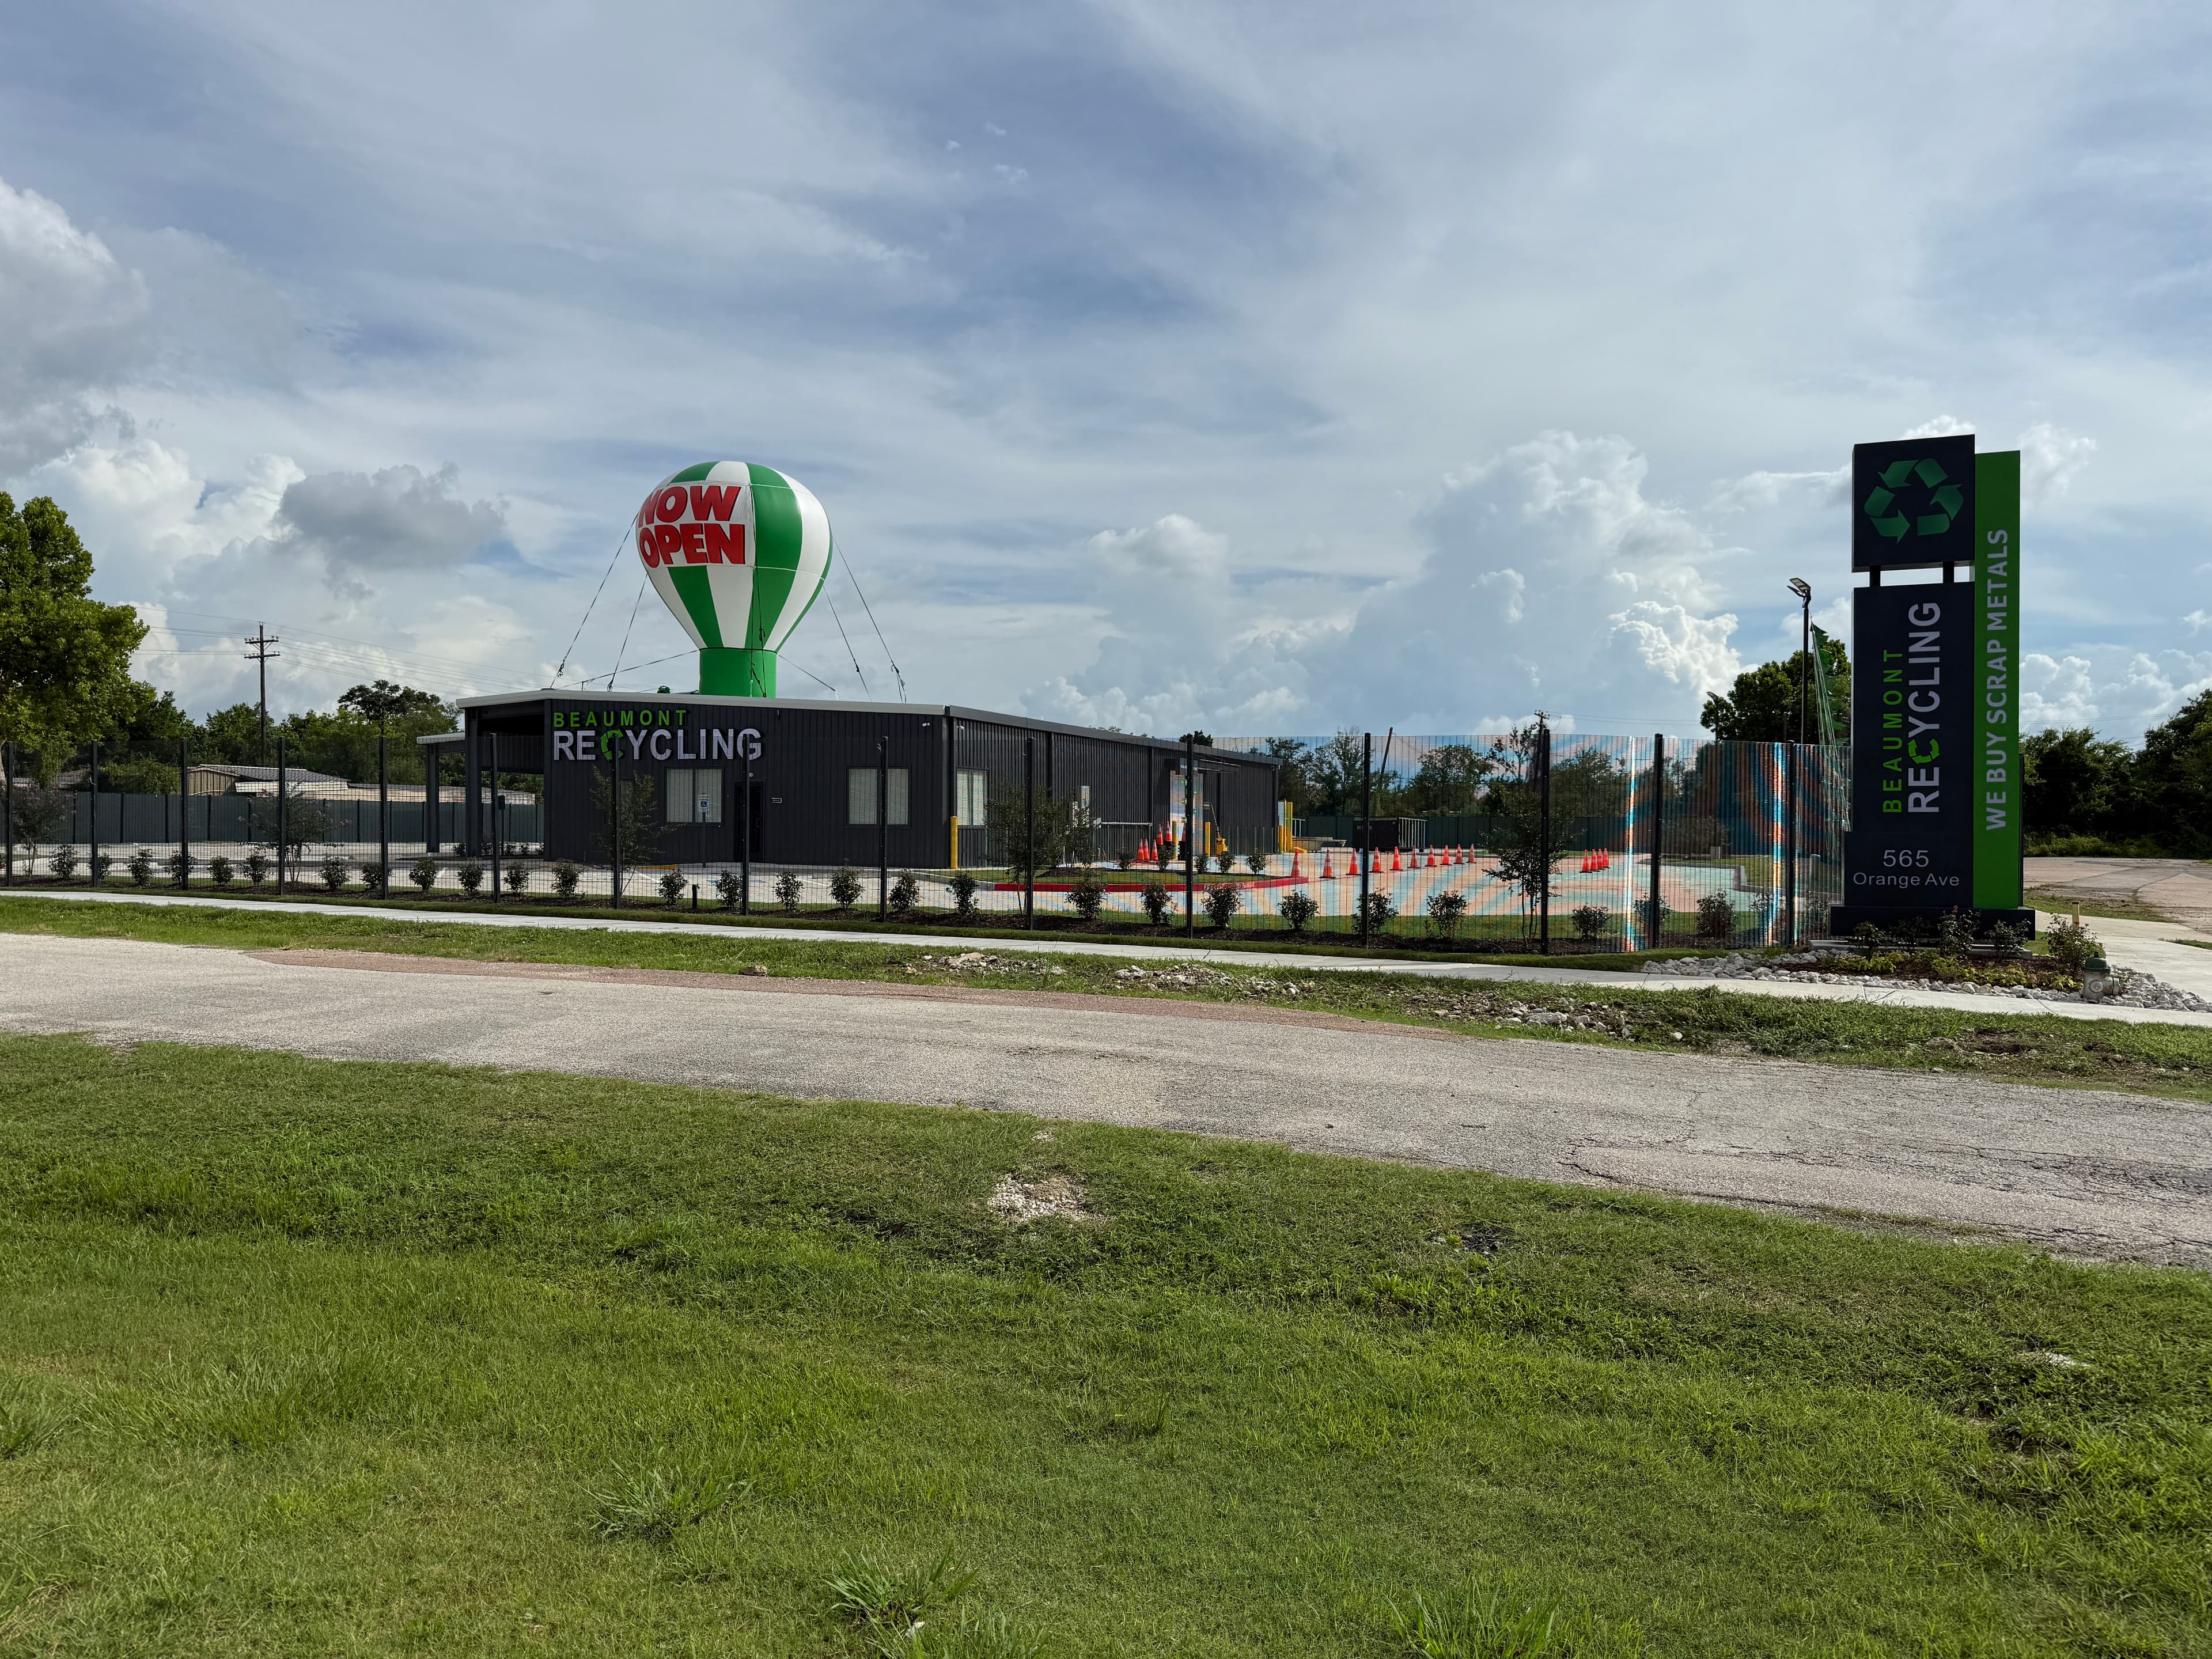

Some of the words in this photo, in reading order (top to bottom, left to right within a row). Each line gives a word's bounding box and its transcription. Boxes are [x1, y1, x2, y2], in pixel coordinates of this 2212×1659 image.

[638, 486, 742, 527] NOW
[639, 523, 746, 568] OPEN
[1987, 528, 2008, 630] METALS
[1986, 639, 2008, 724] SCRAP
[554, 710, 687, 728] BEAUMONT
[1907, 602, 1941, 813] RECYCLING
[554, 728, 762, 761] RECYCLING
[1883, 649, 1903, 813] BEAUMONT
[1986, 732, 2007, 783] BUY
[1986, 791, 2007, 830] WE
[1853, 872, 1921, 889] Orange
[1925, 873, 1960, 886] Ave
[1883, 850, 1929, 868] 565
